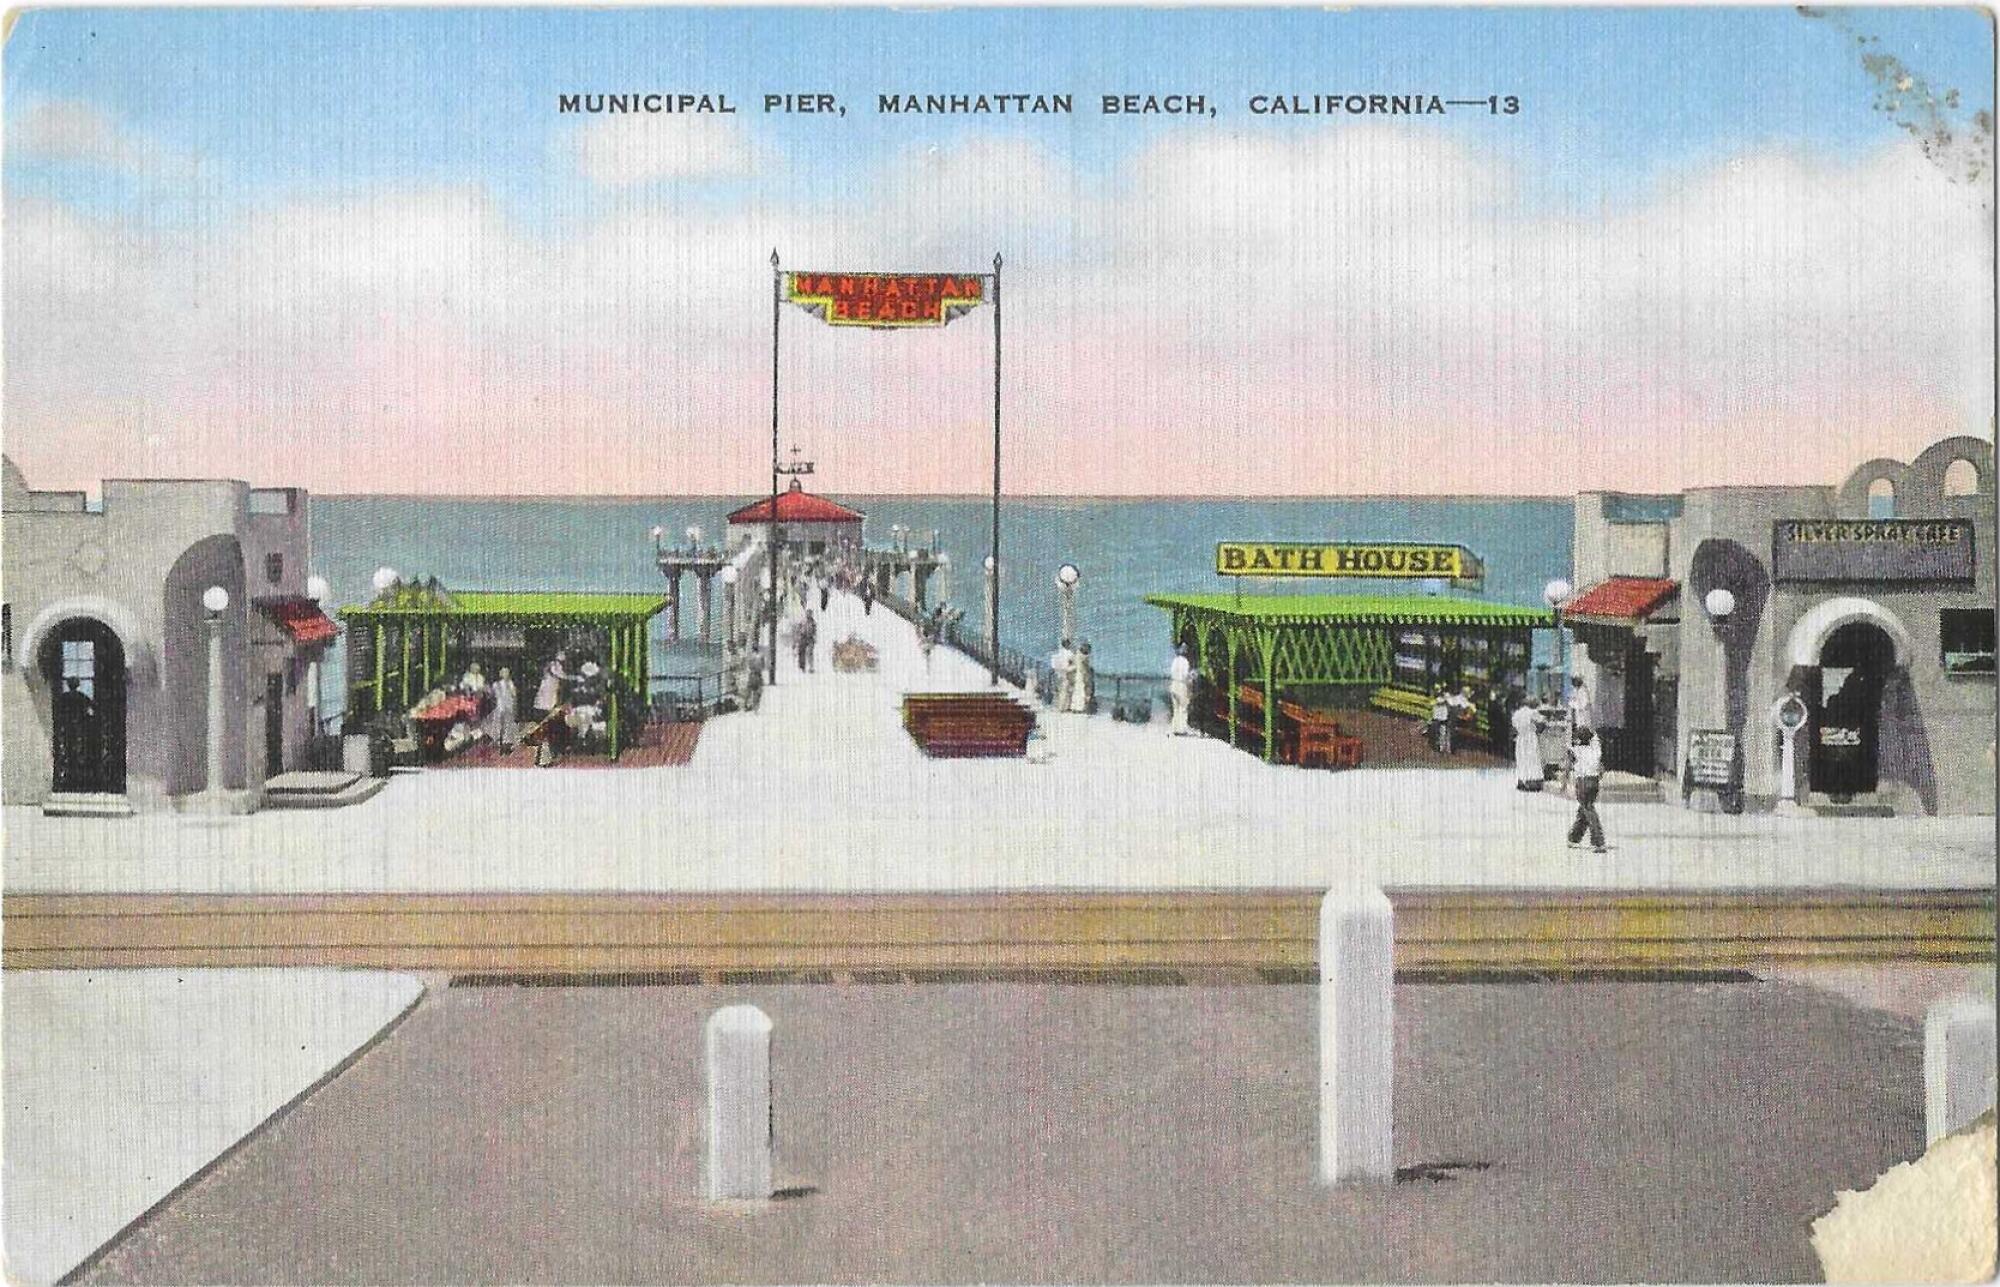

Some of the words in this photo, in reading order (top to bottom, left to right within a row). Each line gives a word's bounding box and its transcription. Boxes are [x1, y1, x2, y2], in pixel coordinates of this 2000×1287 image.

[796, 276, 981, 297] MANHATTAN
[836, 301, 941, 320] BEACH
[1787, 523, 1848, 543] SILVER
[1853, 525, 1910, 543] SPRAY
[1223, 548, 1322, 570] BATH
[1336, 549, 1453, 572] HOUSE
